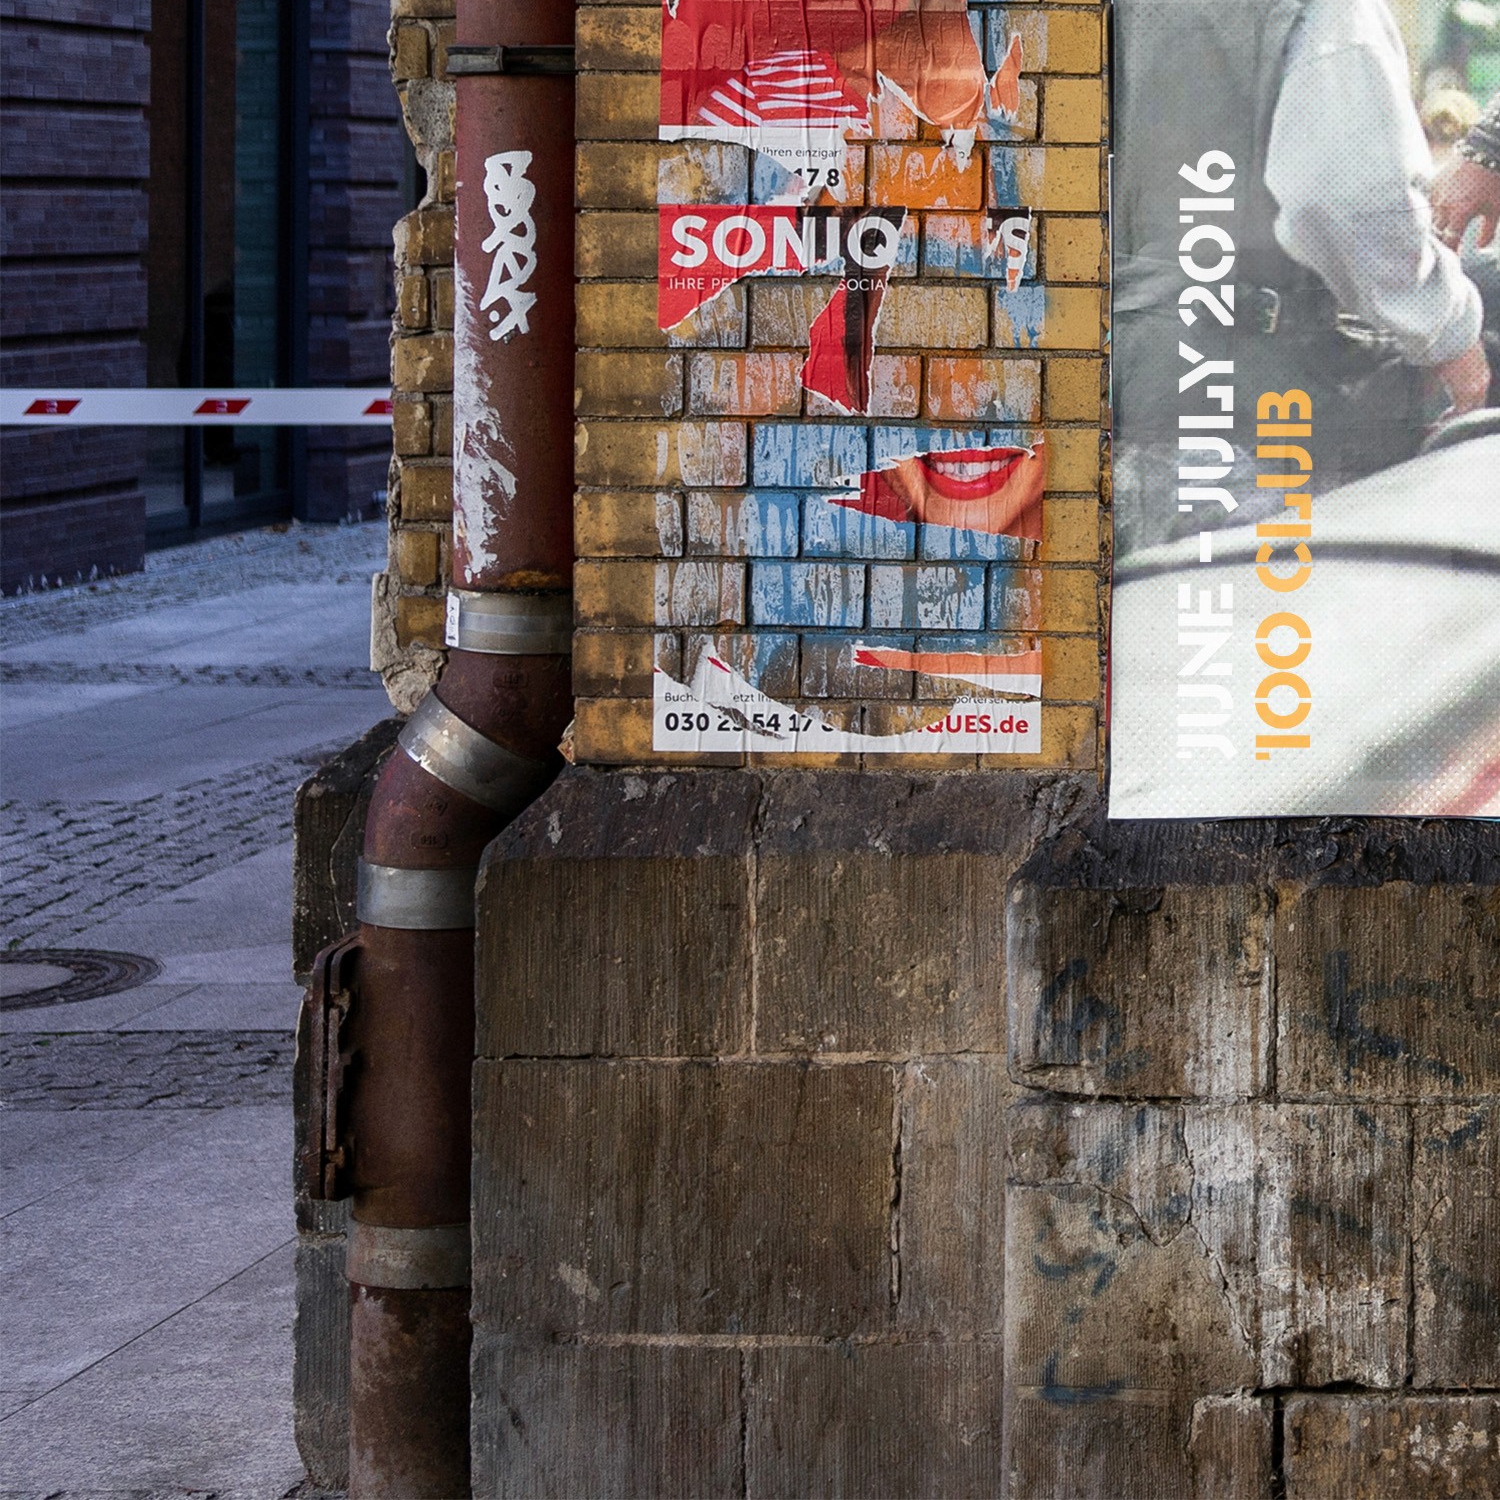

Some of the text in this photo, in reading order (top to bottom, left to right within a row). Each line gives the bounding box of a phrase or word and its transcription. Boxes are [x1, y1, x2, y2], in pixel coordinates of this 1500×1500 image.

[1178, 149, 1237, 328] 2016
[1177, 340, 1238, 513] JULY
[1255, 388, 1313, 761] 100 CLUB
[665, 712, 710, 732] 030
[1177, 583, 1238, 761] JUNE
